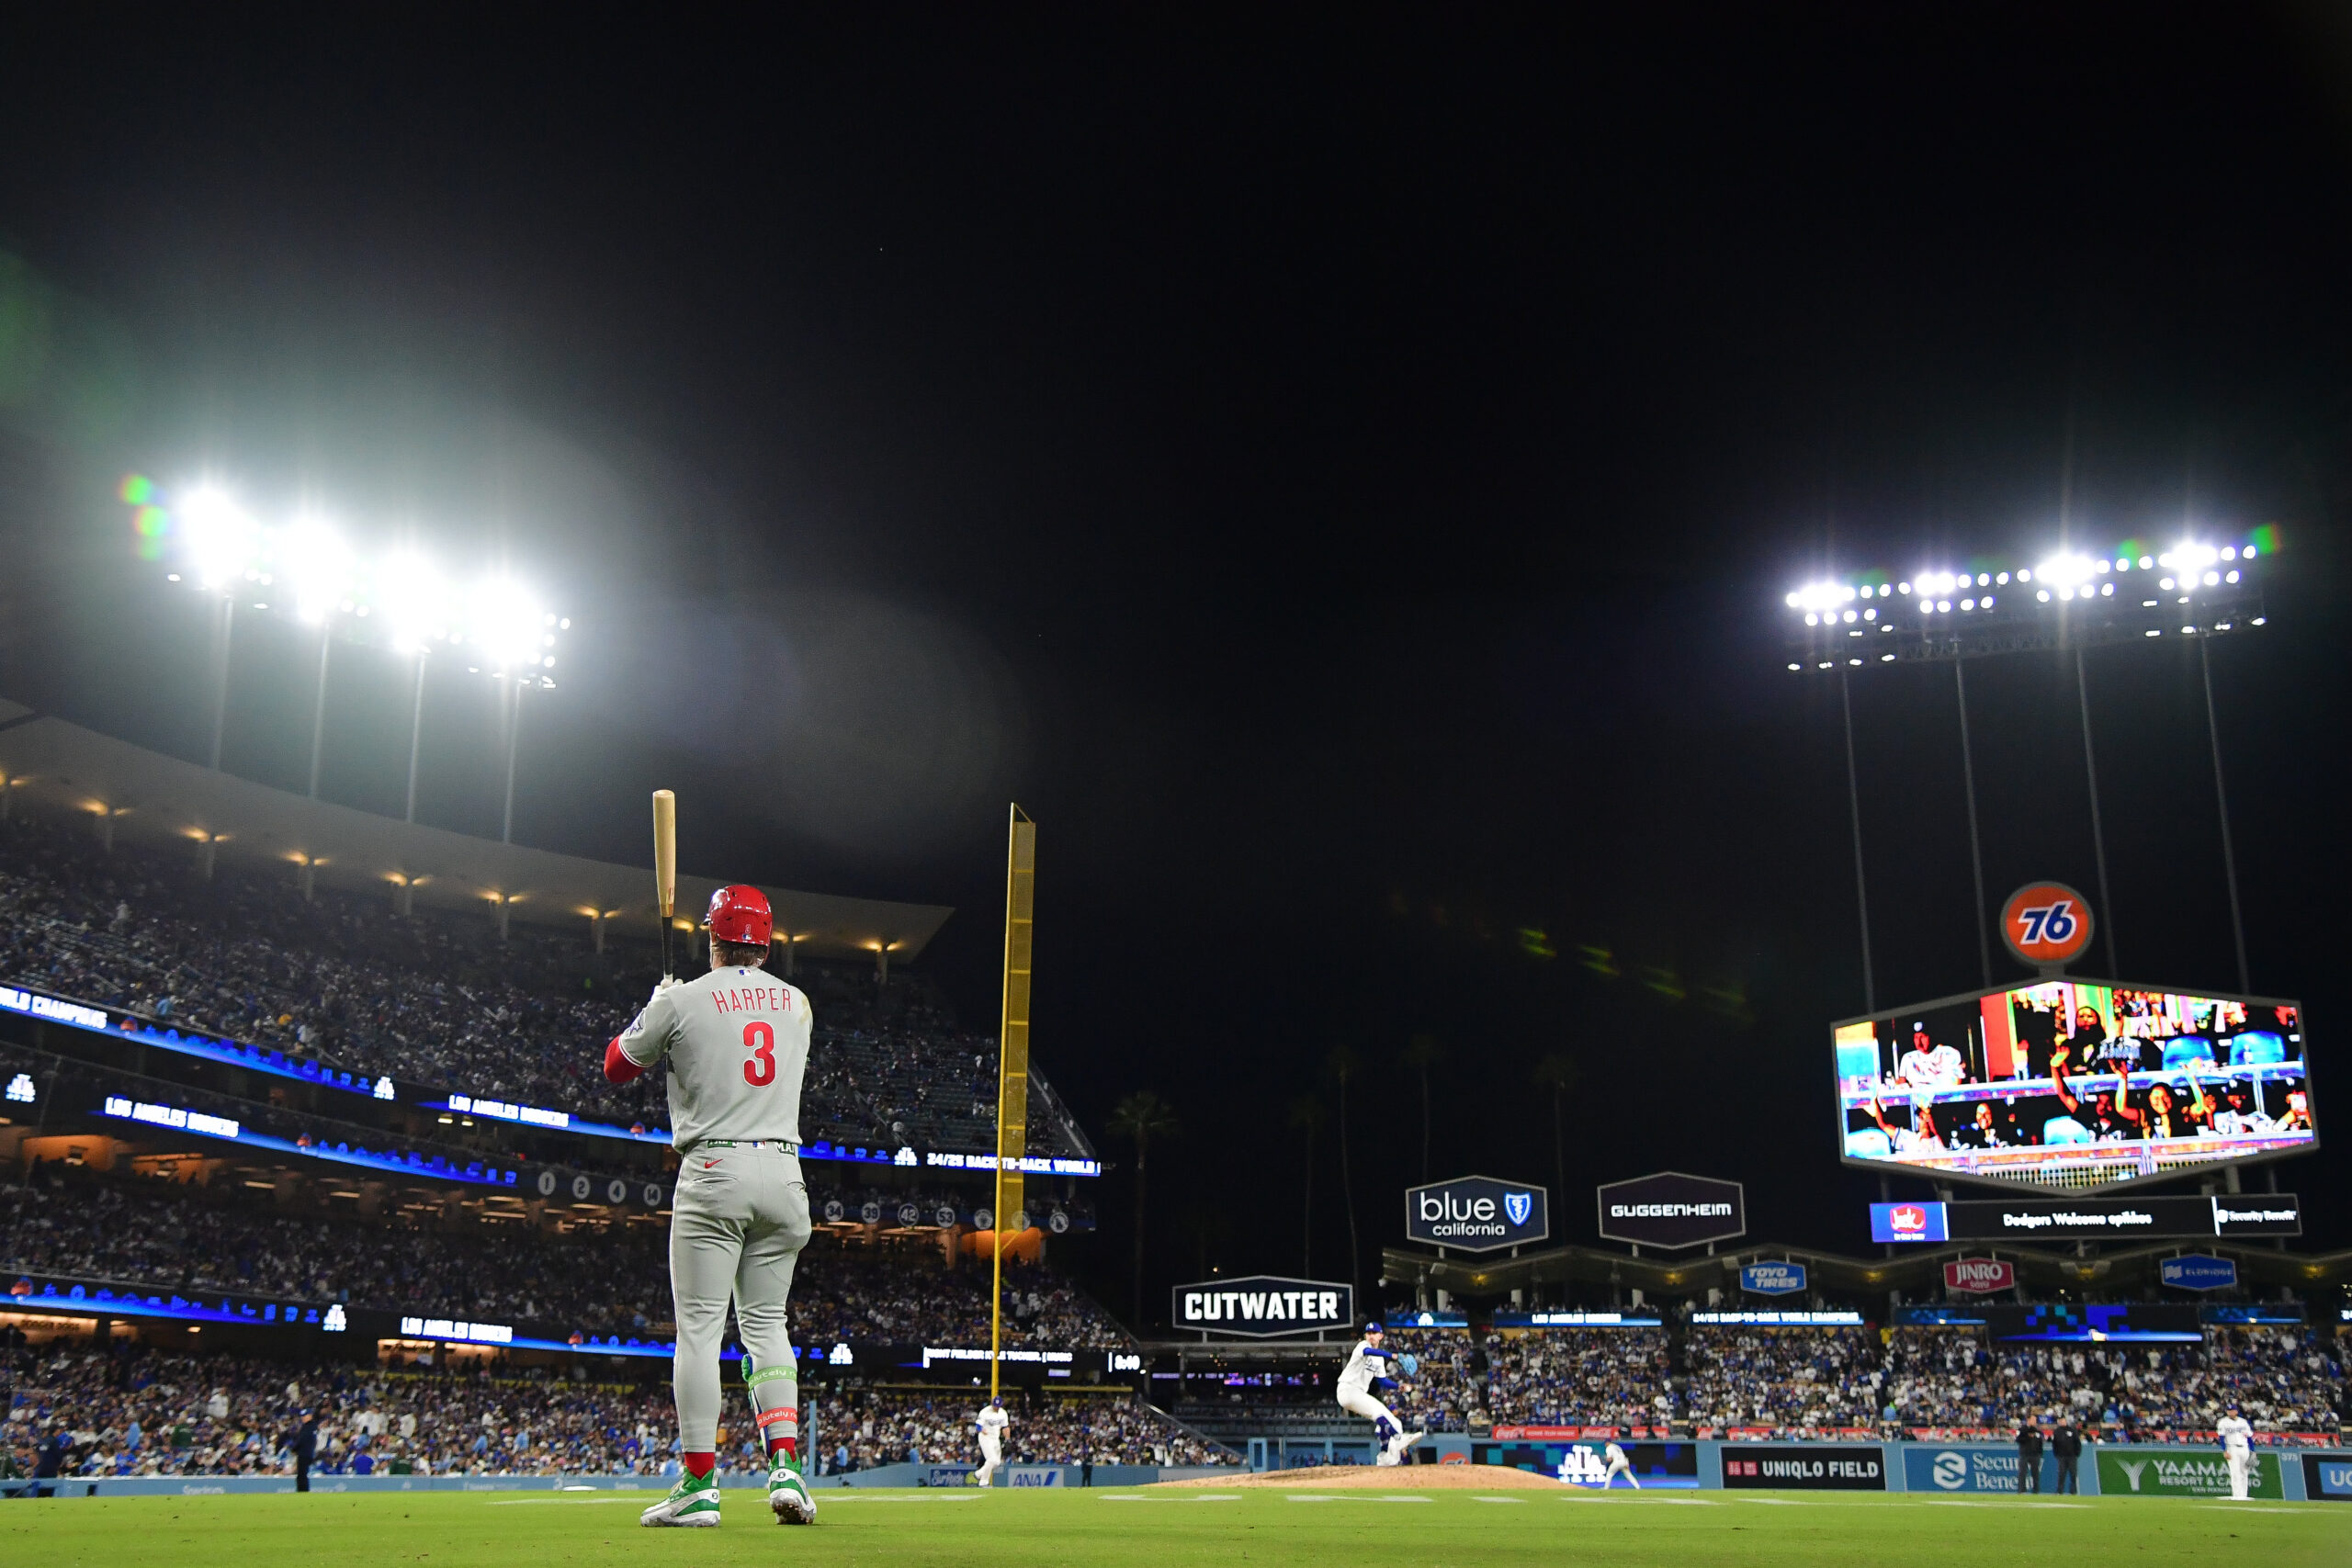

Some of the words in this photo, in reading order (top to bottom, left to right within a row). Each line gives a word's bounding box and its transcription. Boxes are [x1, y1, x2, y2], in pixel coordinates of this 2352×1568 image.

[2018, 899, 2077, 945] 76
[711, 987, 793, 1015] HARPER
[742, 1021, 776, 1088] 3
[927, 1152, 965, 1168] 24/25
[1419, 1191, 1496, 1222] blue
[1611, 1203, 1732, 1217] GUGGENHEIM
[2003, 1213, 2052, 1228] Dodgers
[2052, 1211, 2107, 1226] Welcome
[1432, 1223, 1506, 1236] california
[1748, 1268, 1788, 1279] TOYO
[1956, 1263, 2003, 1285] JINRO
[1755, 1277, 1798, 1288] TIRES
[1185, 1292, 1339, 1321] CUTWATER
[1762, 1461, 1824, 1480] UNIQLO
[1828, 1461, 1879, 1478] FIELD
[1013, 1473, 1042, 1487] ANA
[2159, 1476, 2204, 1486] RESORT
[2206, 1476, 2215, 1486] &
